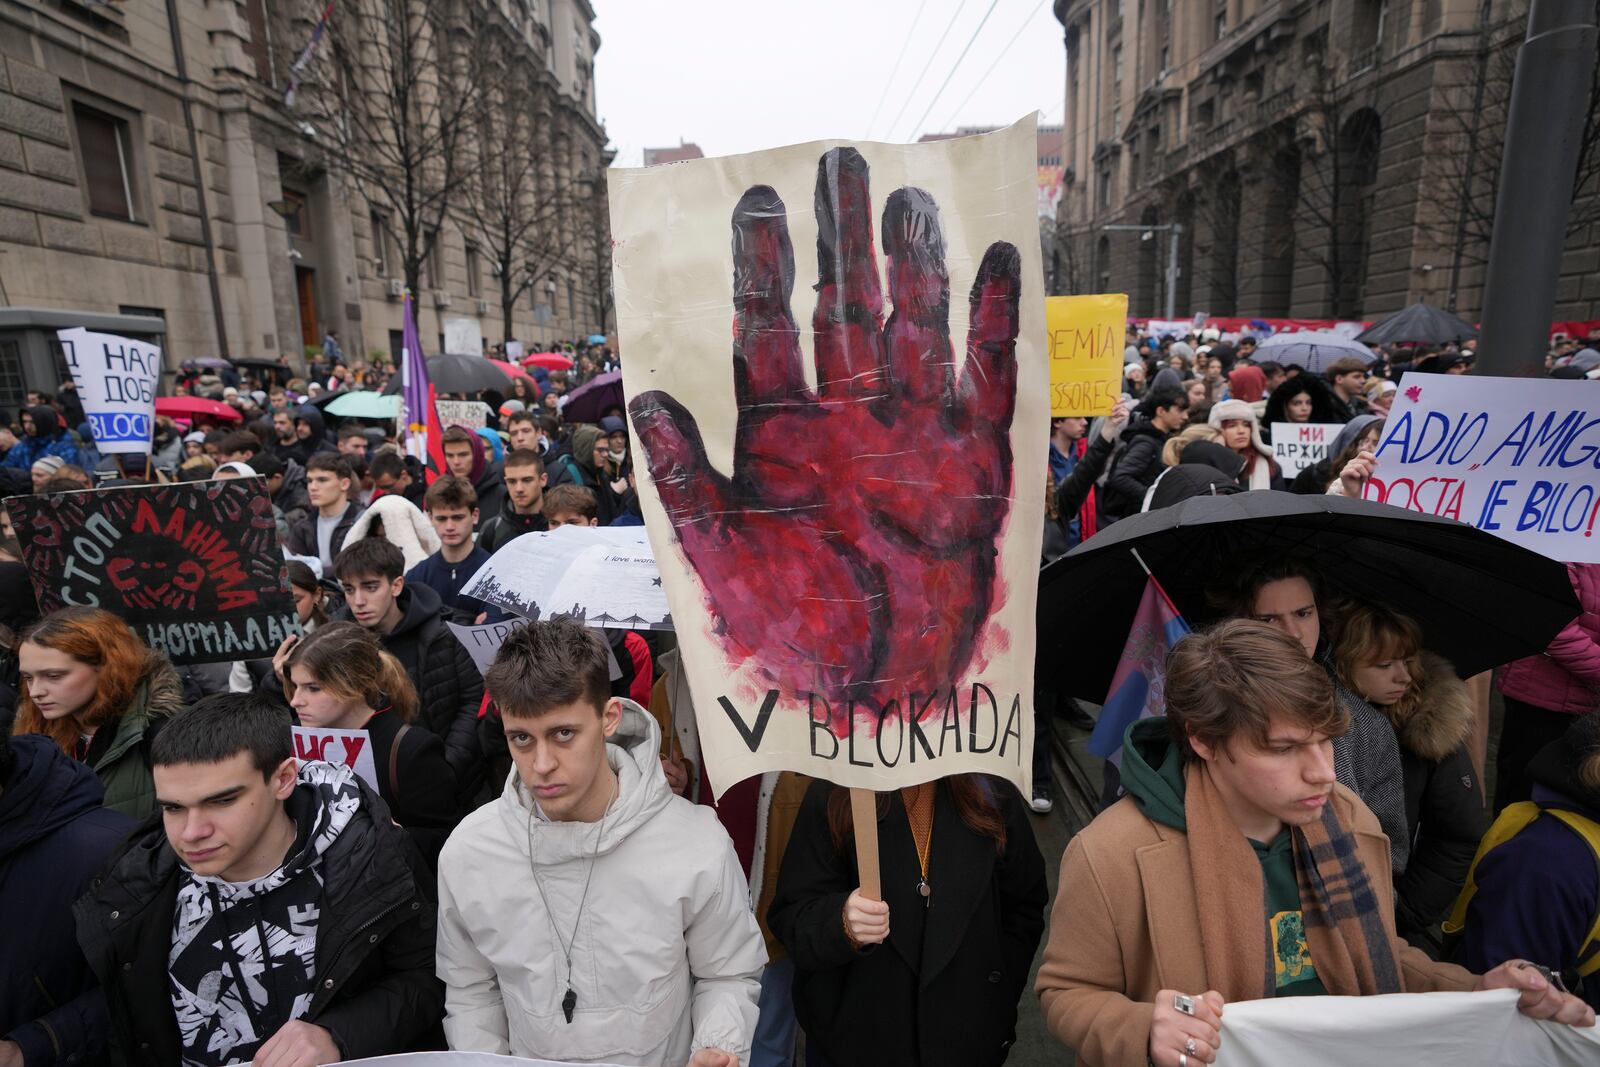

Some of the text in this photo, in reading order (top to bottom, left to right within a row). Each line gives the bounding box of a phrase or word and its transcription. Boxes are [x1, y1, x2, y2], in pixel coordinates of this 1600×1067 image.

[1276, 442, 1331, 459] ДРЖИ
[1299, 427, 1325, 442] МИ
[61, 511, 122, 608] СТОП
[131, 498, 258, 611] ЛАЖИМА
[809, 682, 1020, 768] BLOKADA
